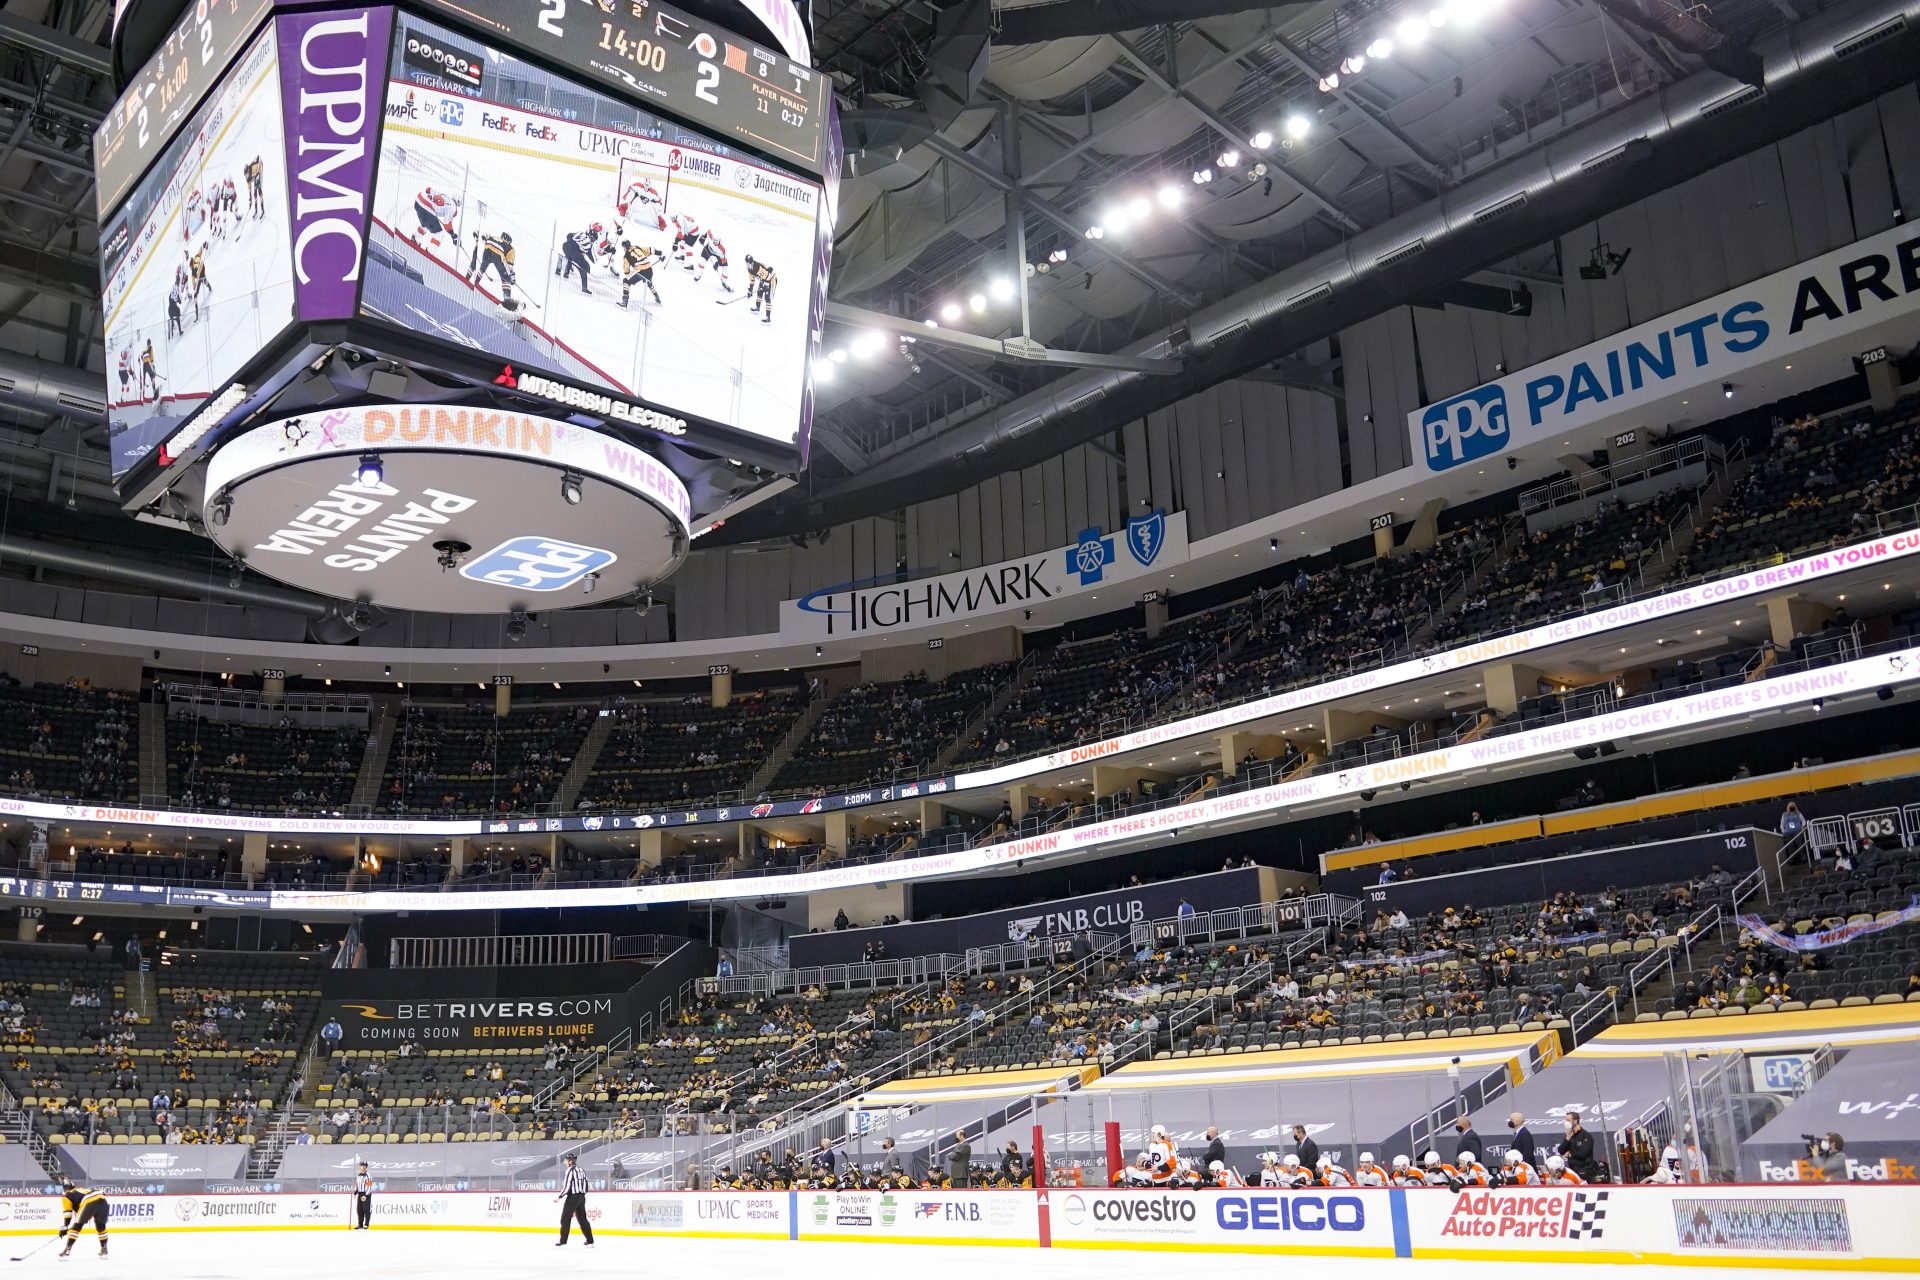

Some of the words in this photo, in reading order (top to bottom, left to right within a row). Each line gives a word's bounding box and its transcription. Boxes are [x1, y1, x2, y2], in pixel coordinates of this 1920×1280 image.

[538, 0, 566, 37] 2
[201, 19, 214, 66] 2
[598, 22, 666, 73] 14:00
[590, 60, 620, 77] RIVERS
[638, 81, 667, 97] CASINO
[759, 62, 768, 77] 8
[160, 57, 188, 113] 14:00
[416, 74, 465, 95] HIGHMARK
[695, 61, 720, 105] 2
[521, 100, 562, 117] HIGHMARK
[752, 83, 777, 101] PLAYER
[779, 95, 809, 114] PENALTY
[424, 100, 437, 116] by
[440, 102, 464, 125] PPG
[757, 97, 769, 115] 11
[781, 110, 804, 128] 0:17
[138, 106, 149, 149] 2
[482, 112, 516, 134] FedEx
[526, 122, 558, 142] FedEx
[295, 12, 369, 285] UPMC
[578, 130, 628, 156] UPMC
[684, 156, 721, 176] LUMBER
[1863, 348, 1886, 365] 203
[1425, 397, 1506, 461] PPG
[1525, 300, 1770, 427] PAINTS
[517, 373, 611, 414] MITSUBISHI
[610, 401, 687, 435] ELECTRIC
[1616, 432, 1636, 447] 202
[363, 407, 566, 456] DUNKIN'
[604, 444, 675, 502] WHERE
[254, 469, 400, 555] ARENA
[1372, 514, 1392, 530] 201
[323, 488, 477, 572] PAINTS
[482, 542, 594, 587] PPG
[827, 559, 1051, 634] HIGHMARK
[1143, 592, 1157, 602] 234
[1456, 632, 1534, 663] DUNKIN'
[1550, 626, 1573, 640] ICE
[1576, 618, 1593, 632] IN
[1596, 606, 1640, 627] YOUR
[1643, 592, 1697, 615] VEINS.
[1702, 578, 1750, 600] COLD
[1755, 564, 1805, 588] BREW
[1810, 557, 1829, 573] IN
[1833, 543, 1888, 566] YOUR
[22, 646, 38, 655] 229
[929, 639, 943, 648] 233
[263, 669, 284, 680] 230
[494, 676, 512, 685] 231
[709, 666, 728, 675] 232
[1070, 738, 1122, 763] DUNKIN'
[1131, 733, 1148, 746] ICE
[1150, 729, 1161, 742] IN
[1163, 722, 1192, 738] YOUR
[1231, 703, 1262, 720] COLD
[1264, 695, 1297, 713] BREW
[1299, 690, 1313, 703] IN
[1315, 681, 1349, 699] YOUR
[1351, 674, 1379, 690] CUP.
[1372, 752, 1452, 783] DUNKIN'
[1470, 738, 1526, 761] WHERE
[1529, 720, 1597, 748] THERE'S
[1601, 707, 1680, 734] HOCKEY,
[1686, 690, 1762, 716] THERE'S
[1767, 670, 1855, 700] DUNKIN'.
[844, 792, 872, 806] 7:00PM
[1, 801, 26, 813] CUP.
[95, 808, 161, 823] DUNKIN'
[171, 815, 189, 824] ICE
[192, 816, 204, 825] IN
[205, 817, 238, 827] YOUR
[279, 820, 310, 830] COLD
[312, 821, 343, 830] BREW
[345, 822, 357, 831] IN
[360, 822, 390, 831] YOUR
[614, 818, 620, 827] 0
[660, 815, 666, 825] 0
[685, 812, 698, 822] 1st
[1007, 834, 1061, 859] DUNKIN'
[1073, 825, 1110, 843] WHERE
[1112, 817, 1157, 836] THERE'S
[1158, 806, 1209, 826] HOCKEY,
[1212, 794, 1261, 814] THERE'S
[1264, 783, 1320, 803] DUNKIN'.
[1855, 818, 1896, 839] 103
[1724, 836, 1747, 849] 102
[734, 880, 773, 893] WHERE
[774, 876, 819, 890] THERE'S
[820, 869, 866, 885] HOCKEY,
[867, 862, 910, 879] THERE'S
[2, 884, 10, 894] 8
[20, 885, 26, 895] 1
[57, 888, 68, 898] 11
[81, 889, 102, 898] 0:17
[1371, 891, 1387, 901] 102
[20, 907, 42, 917] 119
[1046, 909, 1091, 935] FN.B.
[1093, 900, 1144, 928] CLUB
[1279, 906, 1300, 921] 101
[1156, 925, 1175, 938] 101
[1054, 941, 1072, 954] 122
[701, 983, 718, 993] 121
[398, 999, 612, 1019] BETRIVERS.COM
[361, 1027, 416, 1039] COMING
[423, 1027, 460, 1038] SOON
[473, 1025, 544, 1037] BETRIVERS
[548, 1023, 594, 1035] LOUNGE
[1759, 1159, 1826, 1182] FedEx
[1845, 1158, 1919, 1181] FedEx
[211, 1185, 262, 1194] HIGHMARK
[421, 1183, 456, 1192] HIGHMARK
[519, 1181, 545, 1191] HIGHMARK
[615, 1180, 647, 1190] HIGHMARK
[488, 1197, 512, 1211] LEVIN
[698, 1199, 741, 1220] UPMC
[746, 1200, 773, 1209] SPORTS
[836, 1195, 850, 1205] Play
[850, 1196, 858, 1204] to
[857, 1195, 872, 1204] Win
[839, 1205, 868, 1215] ONLINE!
[1093, 1195, 1196, 1222] covestro
[1451, 1191, 1563, 1217] Advance
[746, 1210, 779, 1220] MEDICINE
[837, 1216, 872, 1226] palottery.com
[945, 1202, 983, 1222] F.N.B.
[1216, 1196, 1365, 1231] GEICO
[1441, 1217, 1497, 1238] Auto
[1499, 1215, 1559, 1238] Parts
